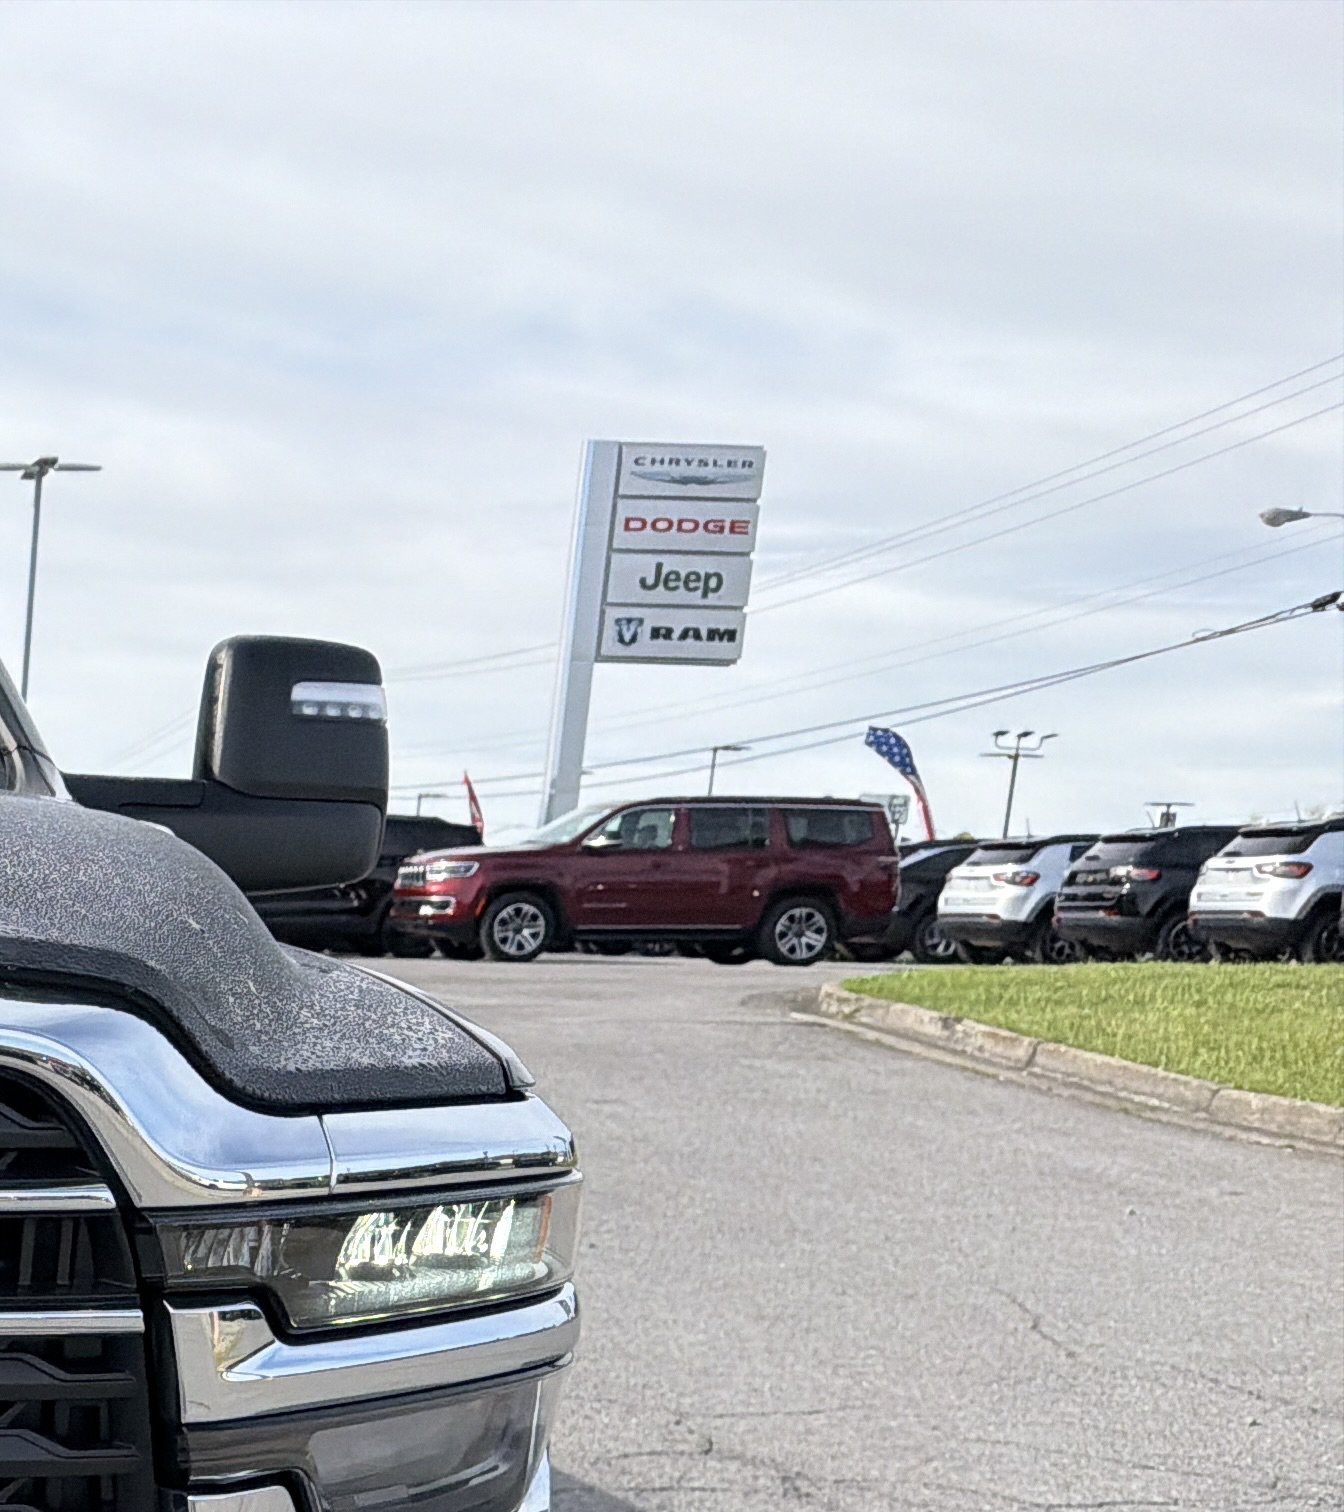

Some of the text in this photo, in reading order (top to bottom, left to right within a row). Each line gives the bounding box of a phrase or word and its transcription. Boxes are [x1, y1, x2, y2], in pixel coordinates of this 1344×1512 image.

[633, 456, 755, 470] CHRYSLER
[623, 516, 751, 535] DODGE
[639, 562, 724, 599] Jeep
[650, 626, 738, 643] RAM
